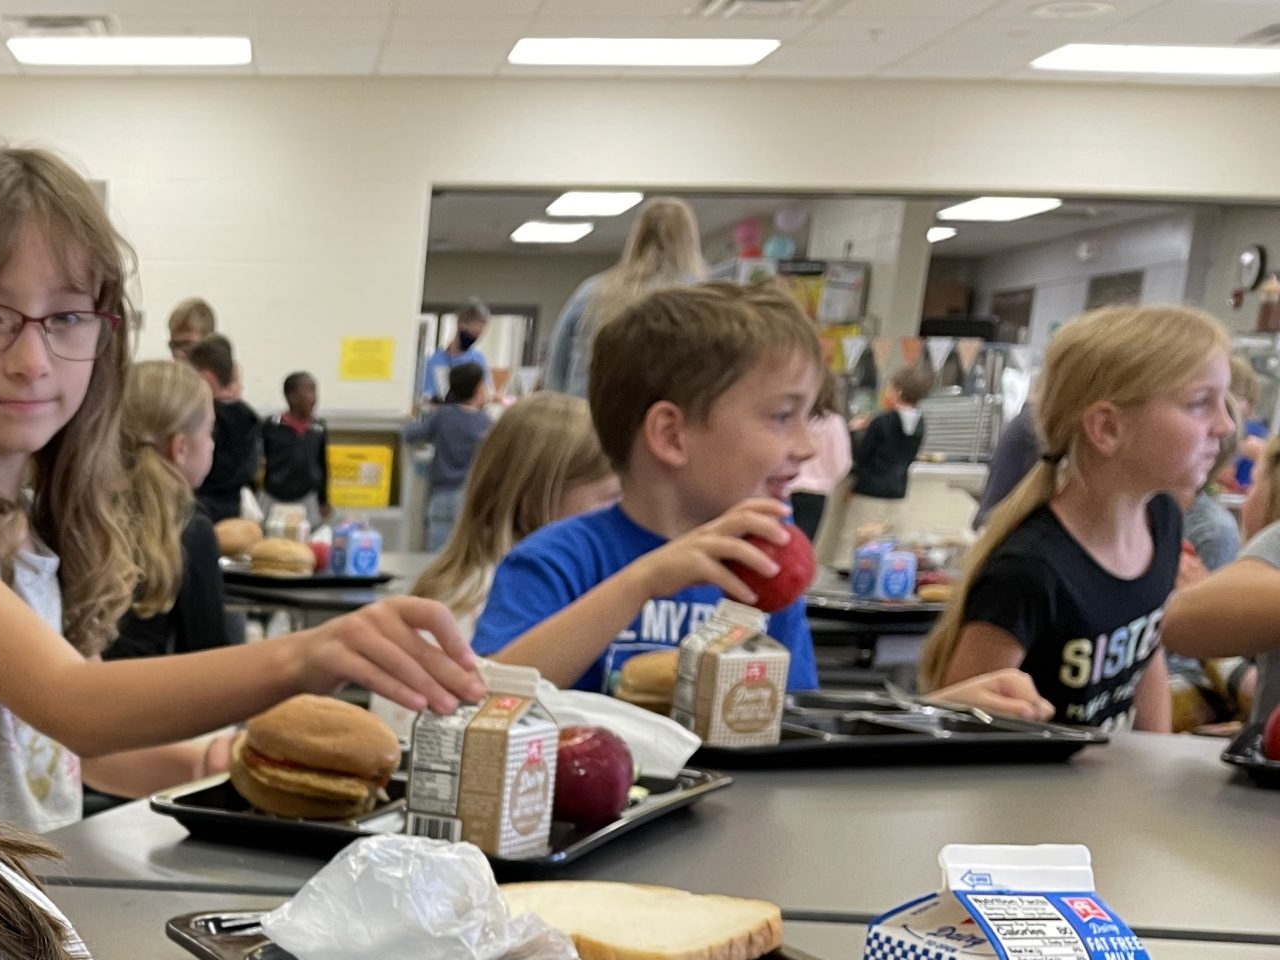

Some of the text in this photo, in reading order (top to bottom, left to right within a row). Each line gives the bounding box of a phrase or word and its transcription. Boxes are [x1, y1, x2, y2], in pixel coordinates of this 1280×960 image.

[641, 599, 687, 643] MY
[1086, 935, 1145, 952] FAT FREE
